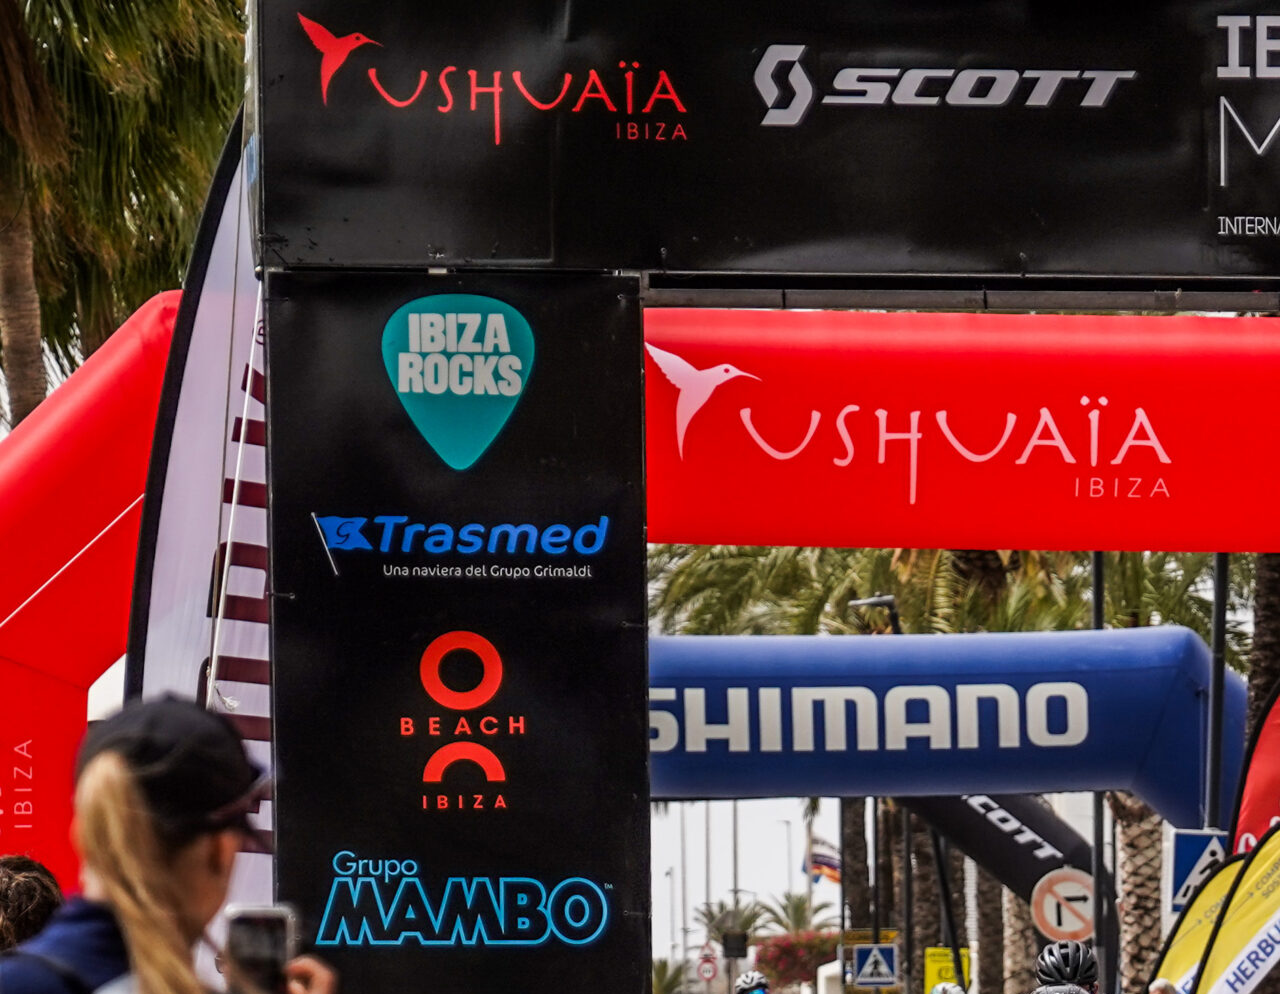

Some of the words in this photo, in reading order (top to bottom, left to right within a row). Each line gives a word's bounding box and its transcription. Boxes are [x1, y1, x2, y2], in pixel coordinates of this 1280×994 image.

[367, 60, 688, 146] USHUAÏA
[821, 68, 1136, 108] SCOTT
[616, 122, 688, 142] IBIZA
[408, 312, 510, 353] IBIZA
[397, 352, 523, 397] ROCKS
[740, 395, 1172, 504] USHUAÏA
[1074, 477, 1171, 498] IBIZA
[374, 515, 609, 555] Trasmed
[383, 564, 409, 577] Una
[412, 564, 463, 577] naviera
[465, 564, 487, 577] del
[490, 564, 530, 579] Grupo
[533, 563, 592, 578] Grimaldi
[400, 716, 526, 736] BEACH
[648, 681, 1089, 753] SHIMANO
[14, 739, 33, 829] IBIZA
[422, 794, 507, 809] IBIZA
[961, 793, 1064, 861] COTT
[332, 851, 418, 885] Grupo
[315, 877, 608, 945] MAMBO
